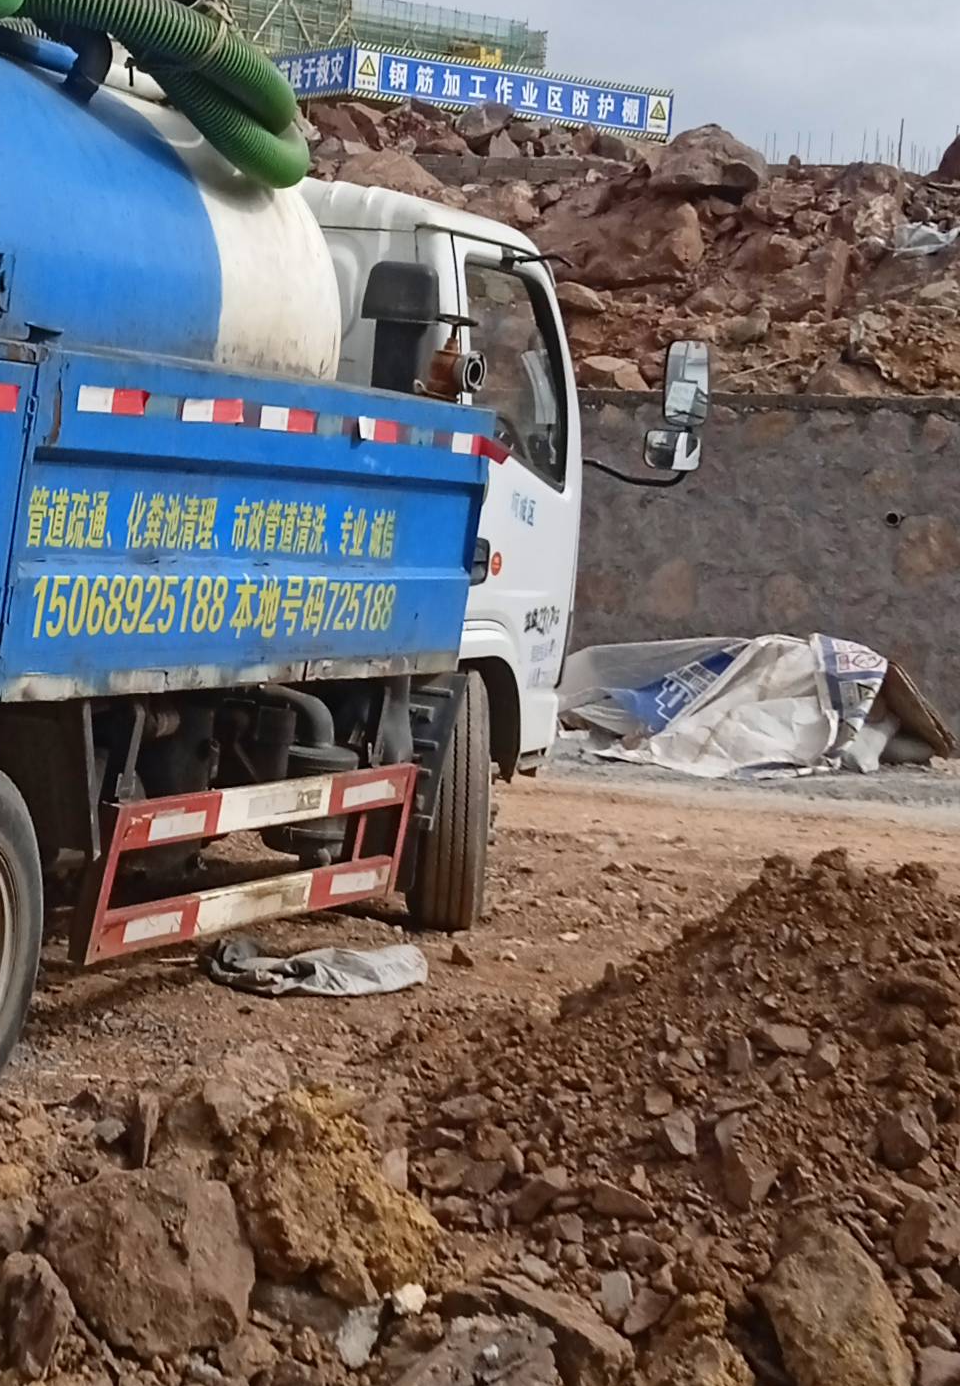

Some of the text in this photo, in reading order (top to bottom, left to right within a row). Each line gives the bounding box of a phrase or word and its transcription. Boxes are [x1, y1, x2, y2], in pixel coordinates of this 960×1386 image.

[388, 60, 640, 125] 钢筋加工作业区防护棚
[26, 485, 112, 549] 管道疏通、
[125, 491, 218, 551] 化粪池清理、
[339, 505, 367, 557] 专业
[32, 573, 397, 639] 15068925188 本地号码725188
